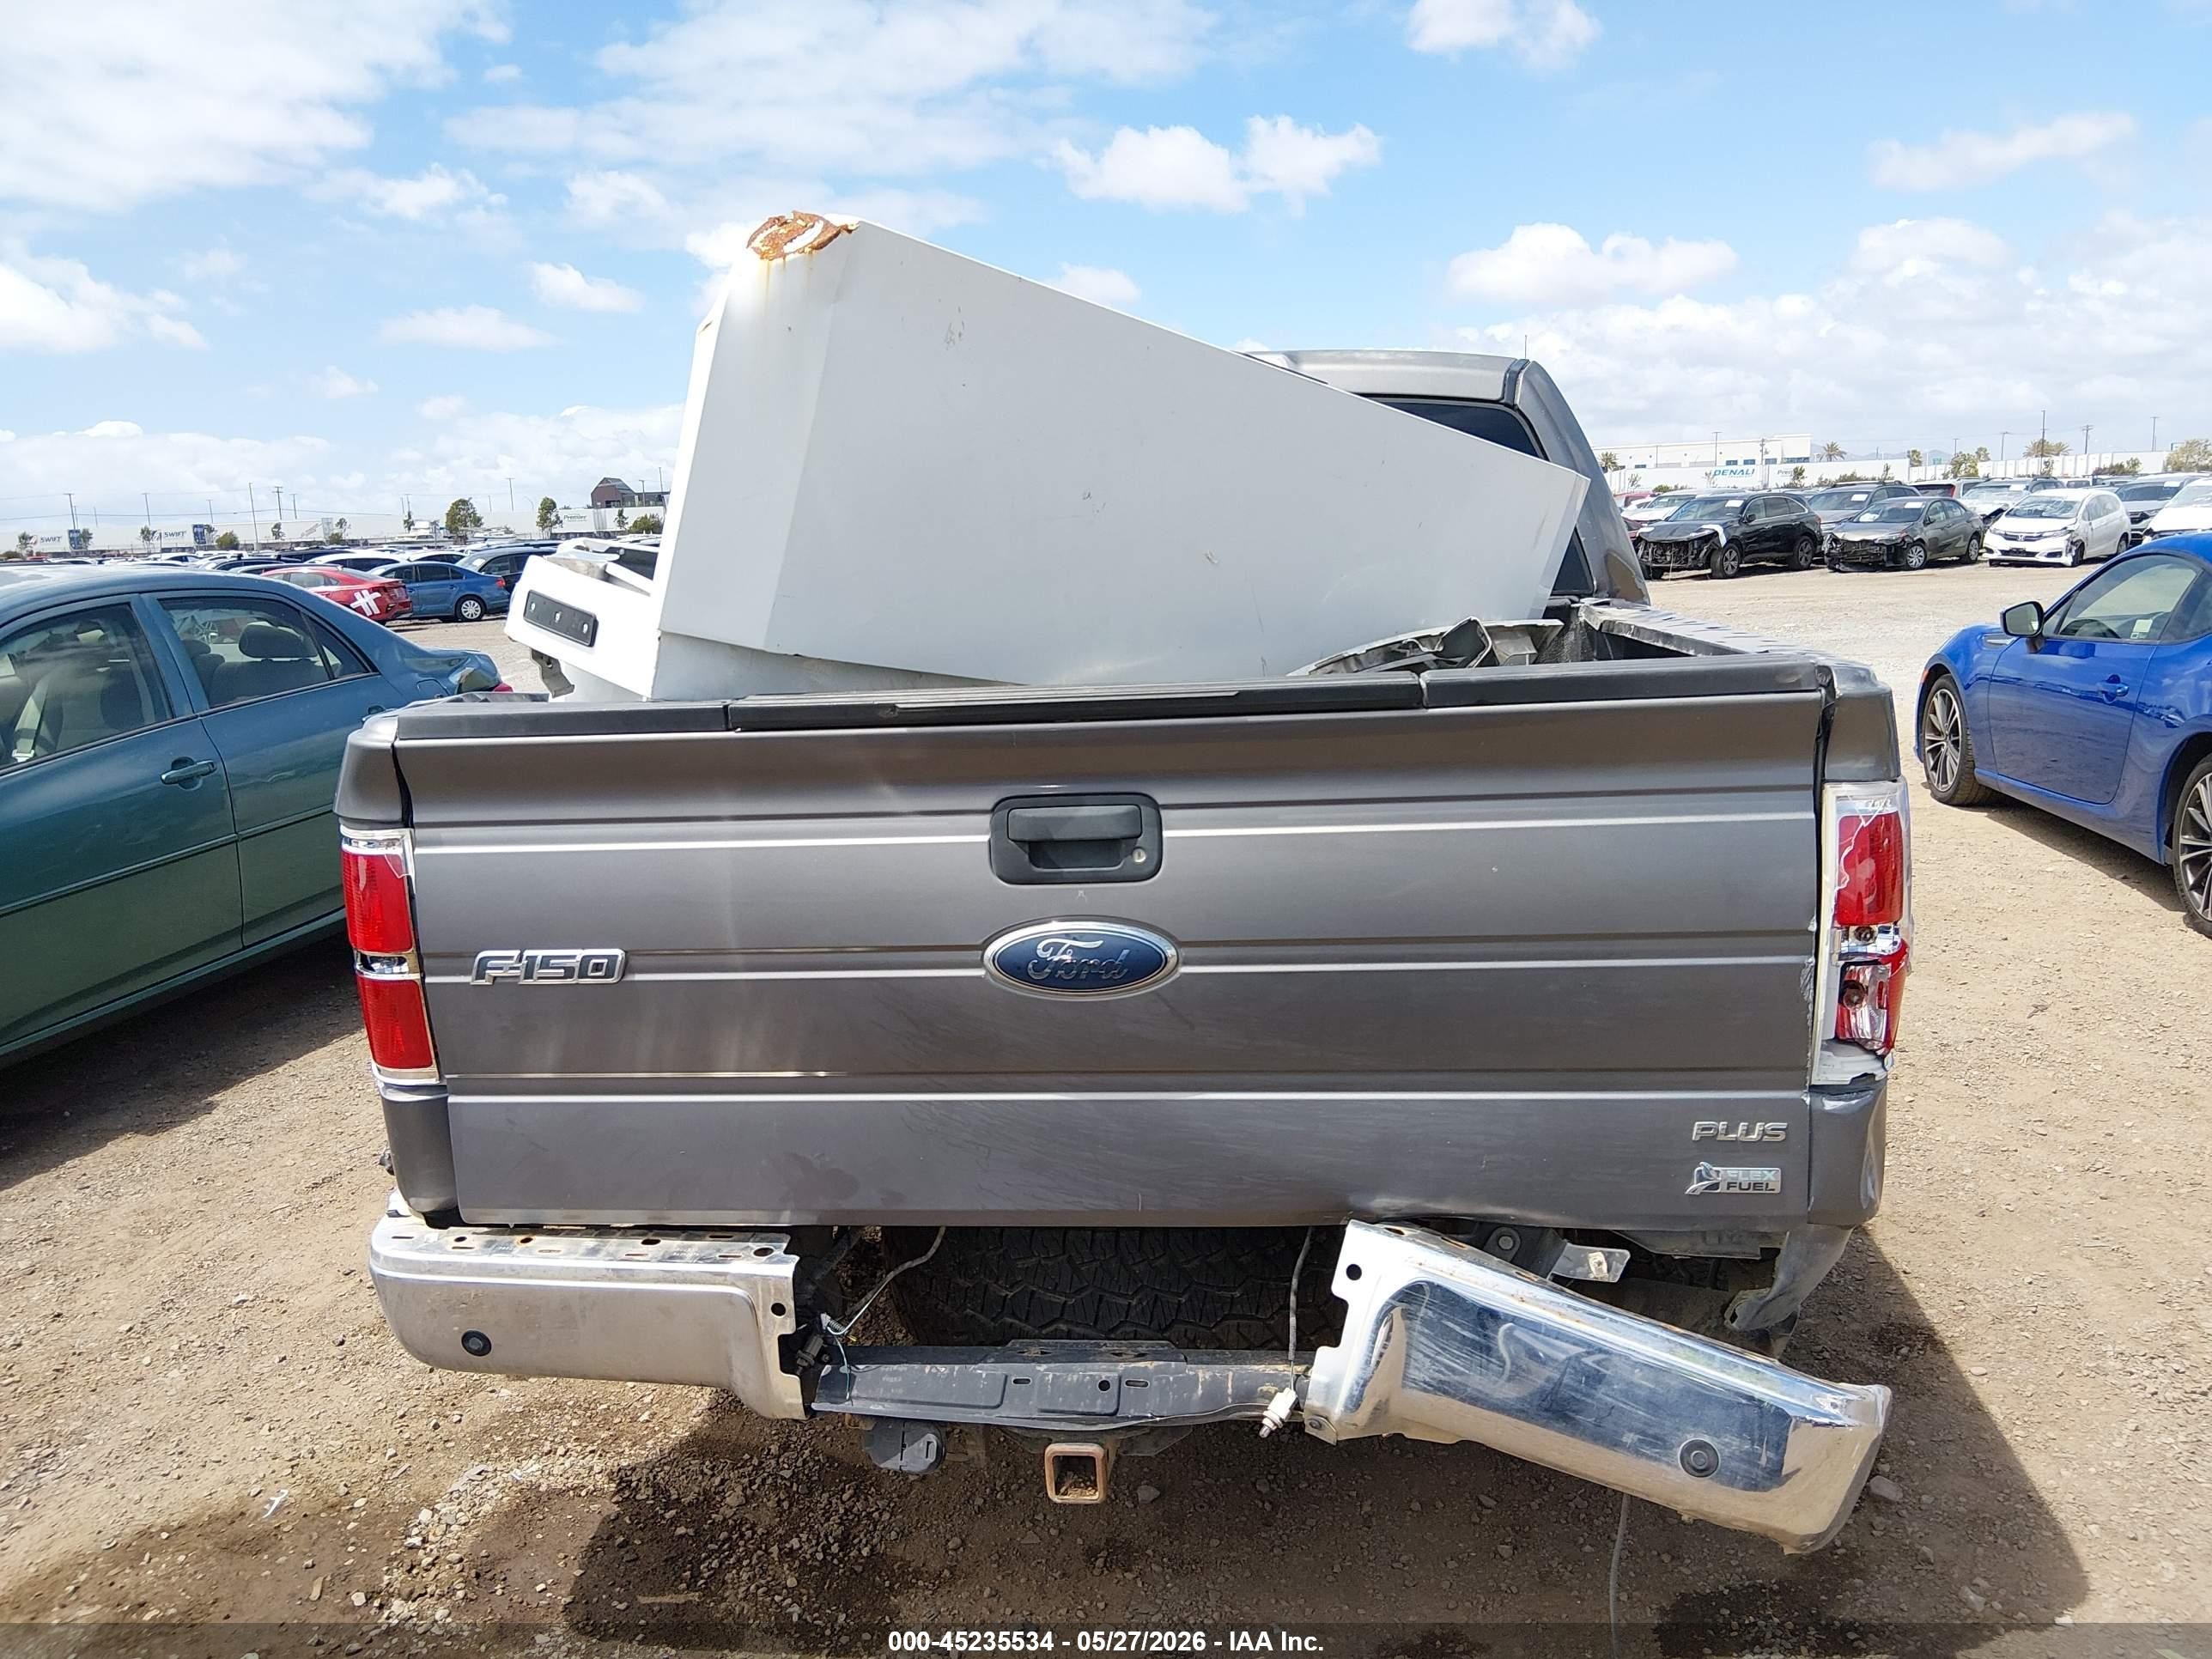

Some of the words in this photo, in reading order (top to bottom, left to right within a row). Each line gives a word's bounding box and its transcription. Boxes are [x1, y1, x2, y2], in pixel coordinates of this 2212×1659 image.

[1026, 938, 1130, 981] Ford
[1692, 1121, 1789, 1142] PLUS
[1727, 1170, 1777, 1181] FLEX
[1726, 1182, 1776, 1192] FUEL
